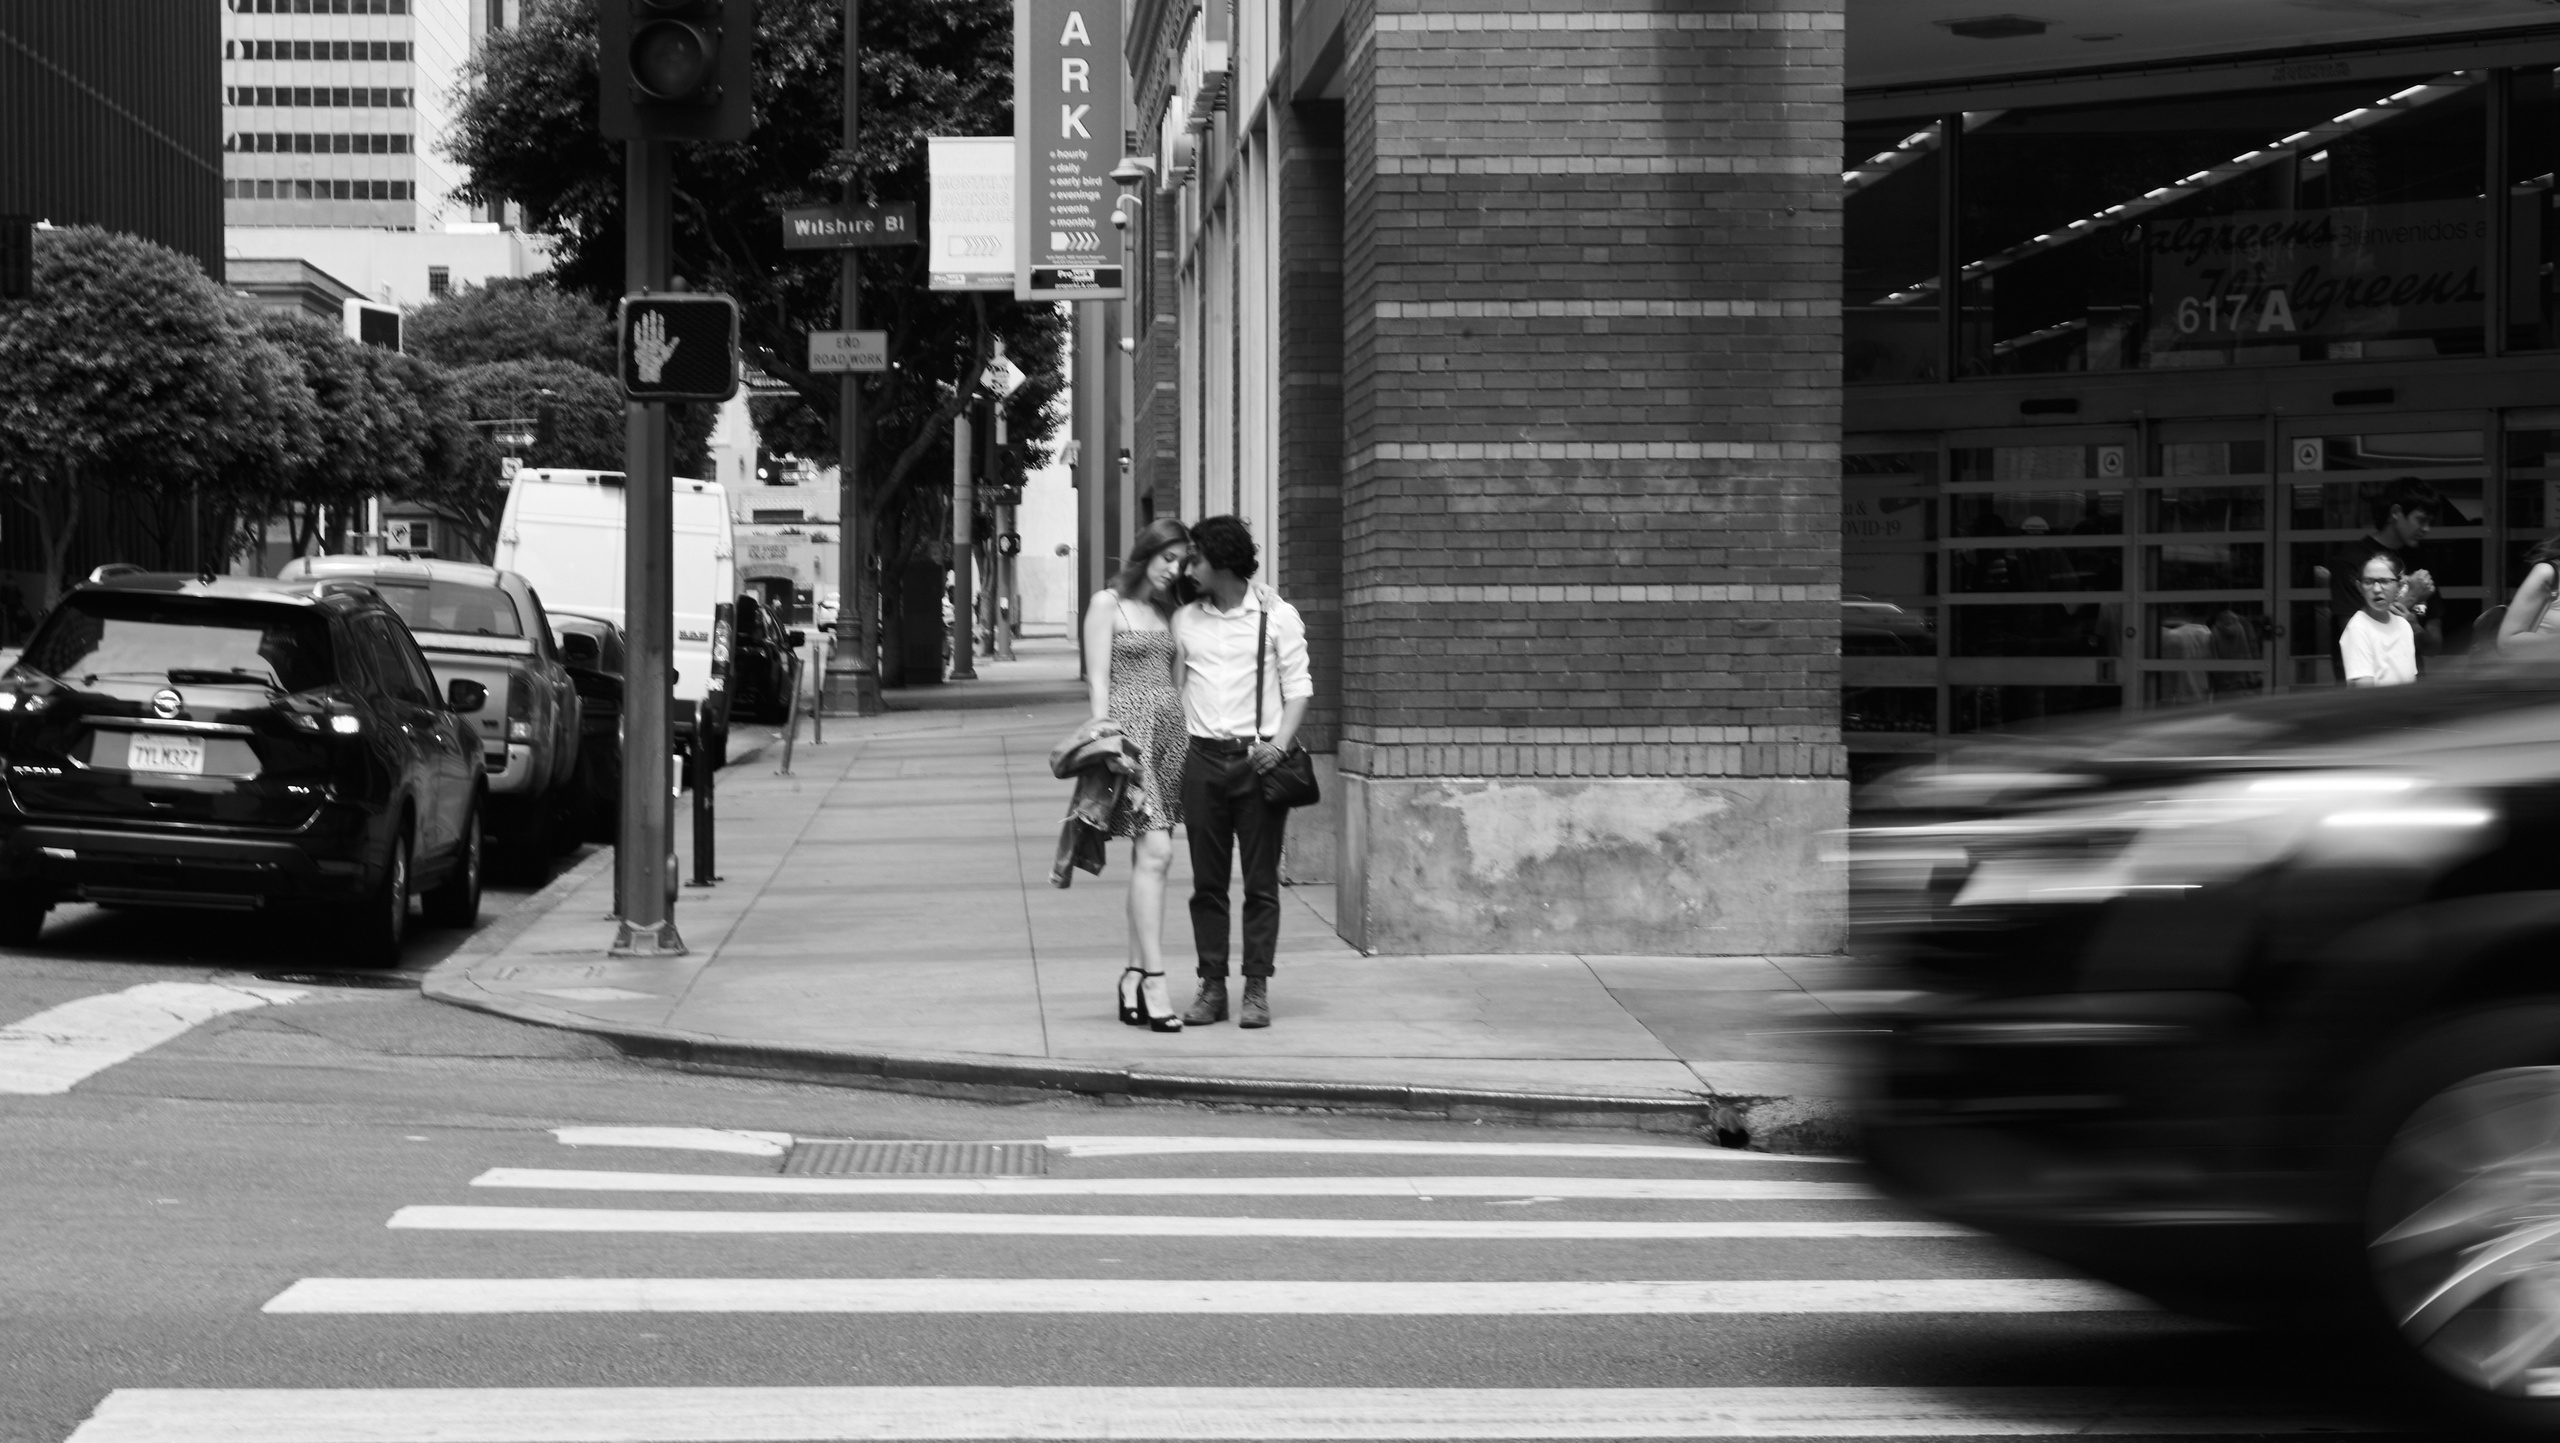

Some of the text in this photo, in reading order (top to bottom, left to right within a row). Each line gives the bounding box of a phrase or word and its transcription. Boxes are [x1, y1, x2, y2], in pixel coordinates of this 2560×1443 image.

[1057, 149, 1088, 161] hourly
[1057, 163, 1081, 175] daily
[938, 175, 1009, 190] MONTHLY
[1057, 176, 1103, 189] early bird
[941, 191, 1010, 206] PARKING
[1057, 190, 1101, 202] evenings
[1057, 204, 1090, 215] events
[794, 215, 905, 236] Wilshire Bl
[1057, 217, 1097, 229] monthly
[2338, 219, 2467, 247] Bienvenidos
[836, 336, 861, 349] END
[813, 353, 883, 366] ROAD WORK
[751, 377, 792, 388] Wilsh
[134, 745, 199, 770] 7YLM327
